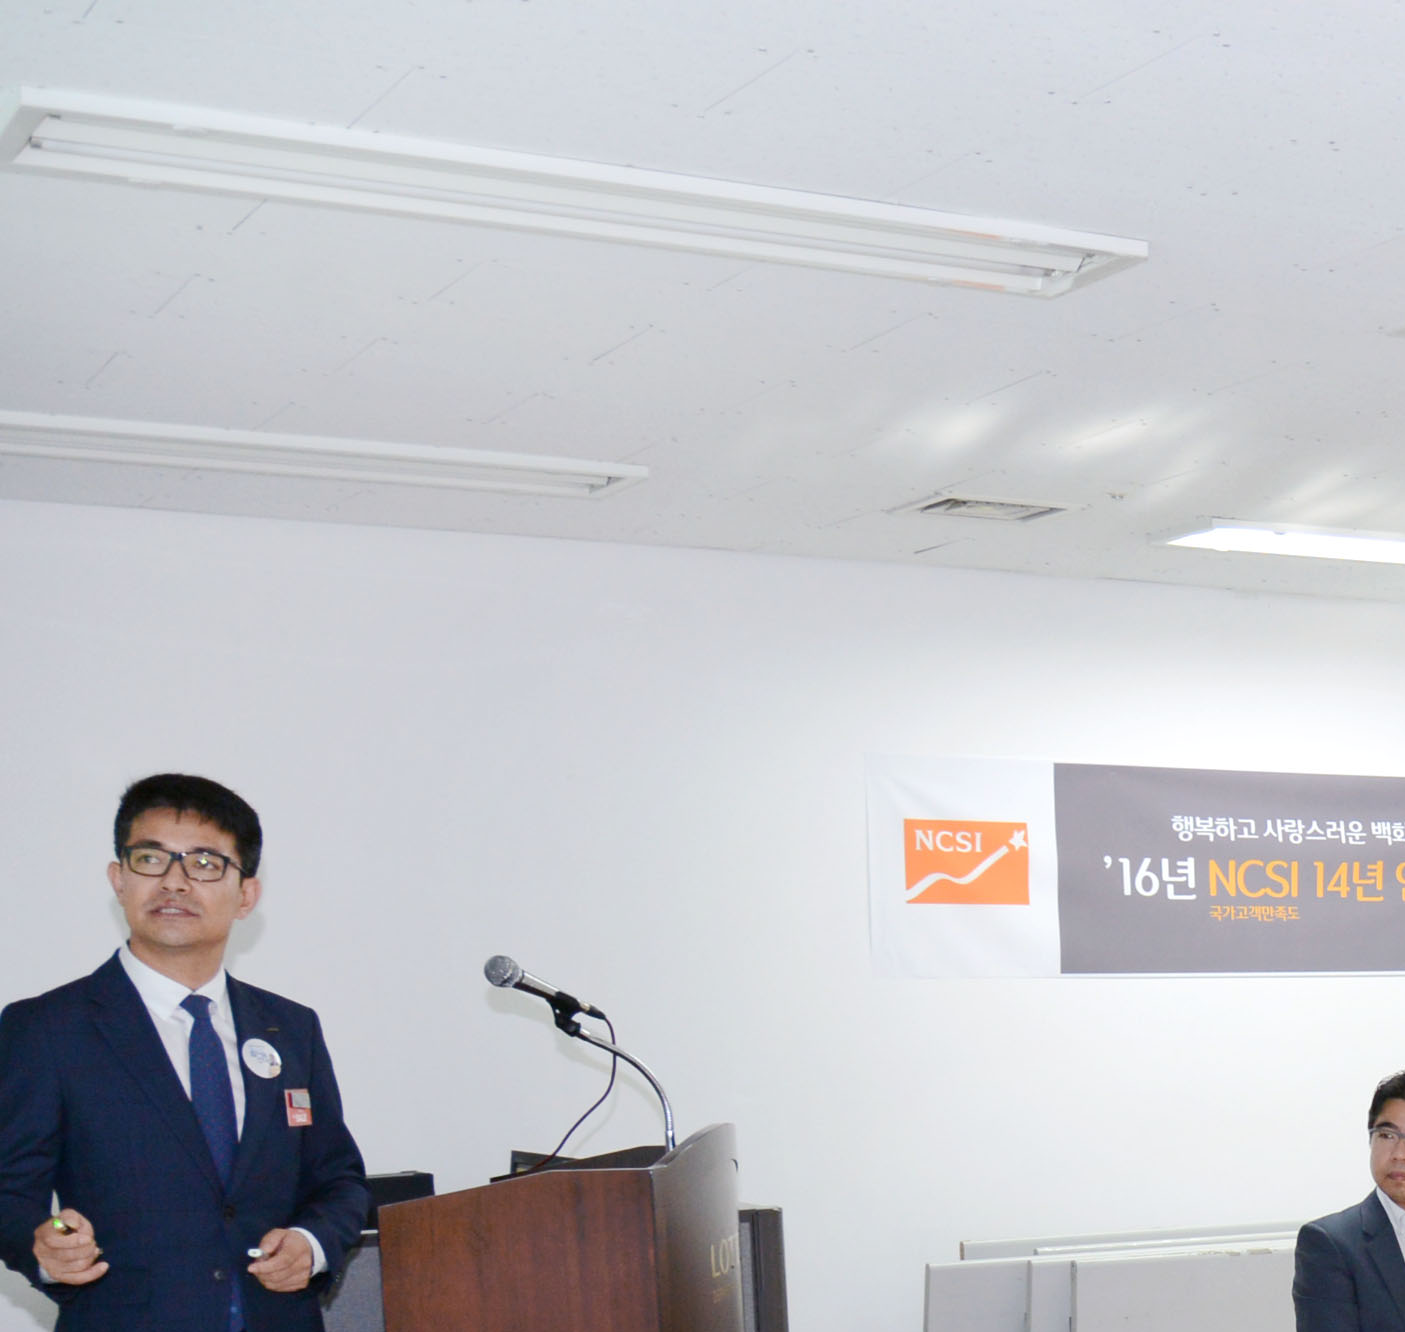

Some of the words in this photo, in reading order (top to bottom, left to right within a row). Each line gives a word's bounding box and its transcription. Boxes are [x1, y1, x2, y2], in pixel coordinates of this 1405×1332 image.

[915, 829, 983, 853] NCSI
[1171, 815, 1259, 842] 행복하고
[1263, 818, 1367, 845] 사랑스러운
[1208, 859, 1299, 898] NCSI
[1313, 860, 1384, 902] 14년
[1209, 905, 1300, 922] 국가고객만족도
